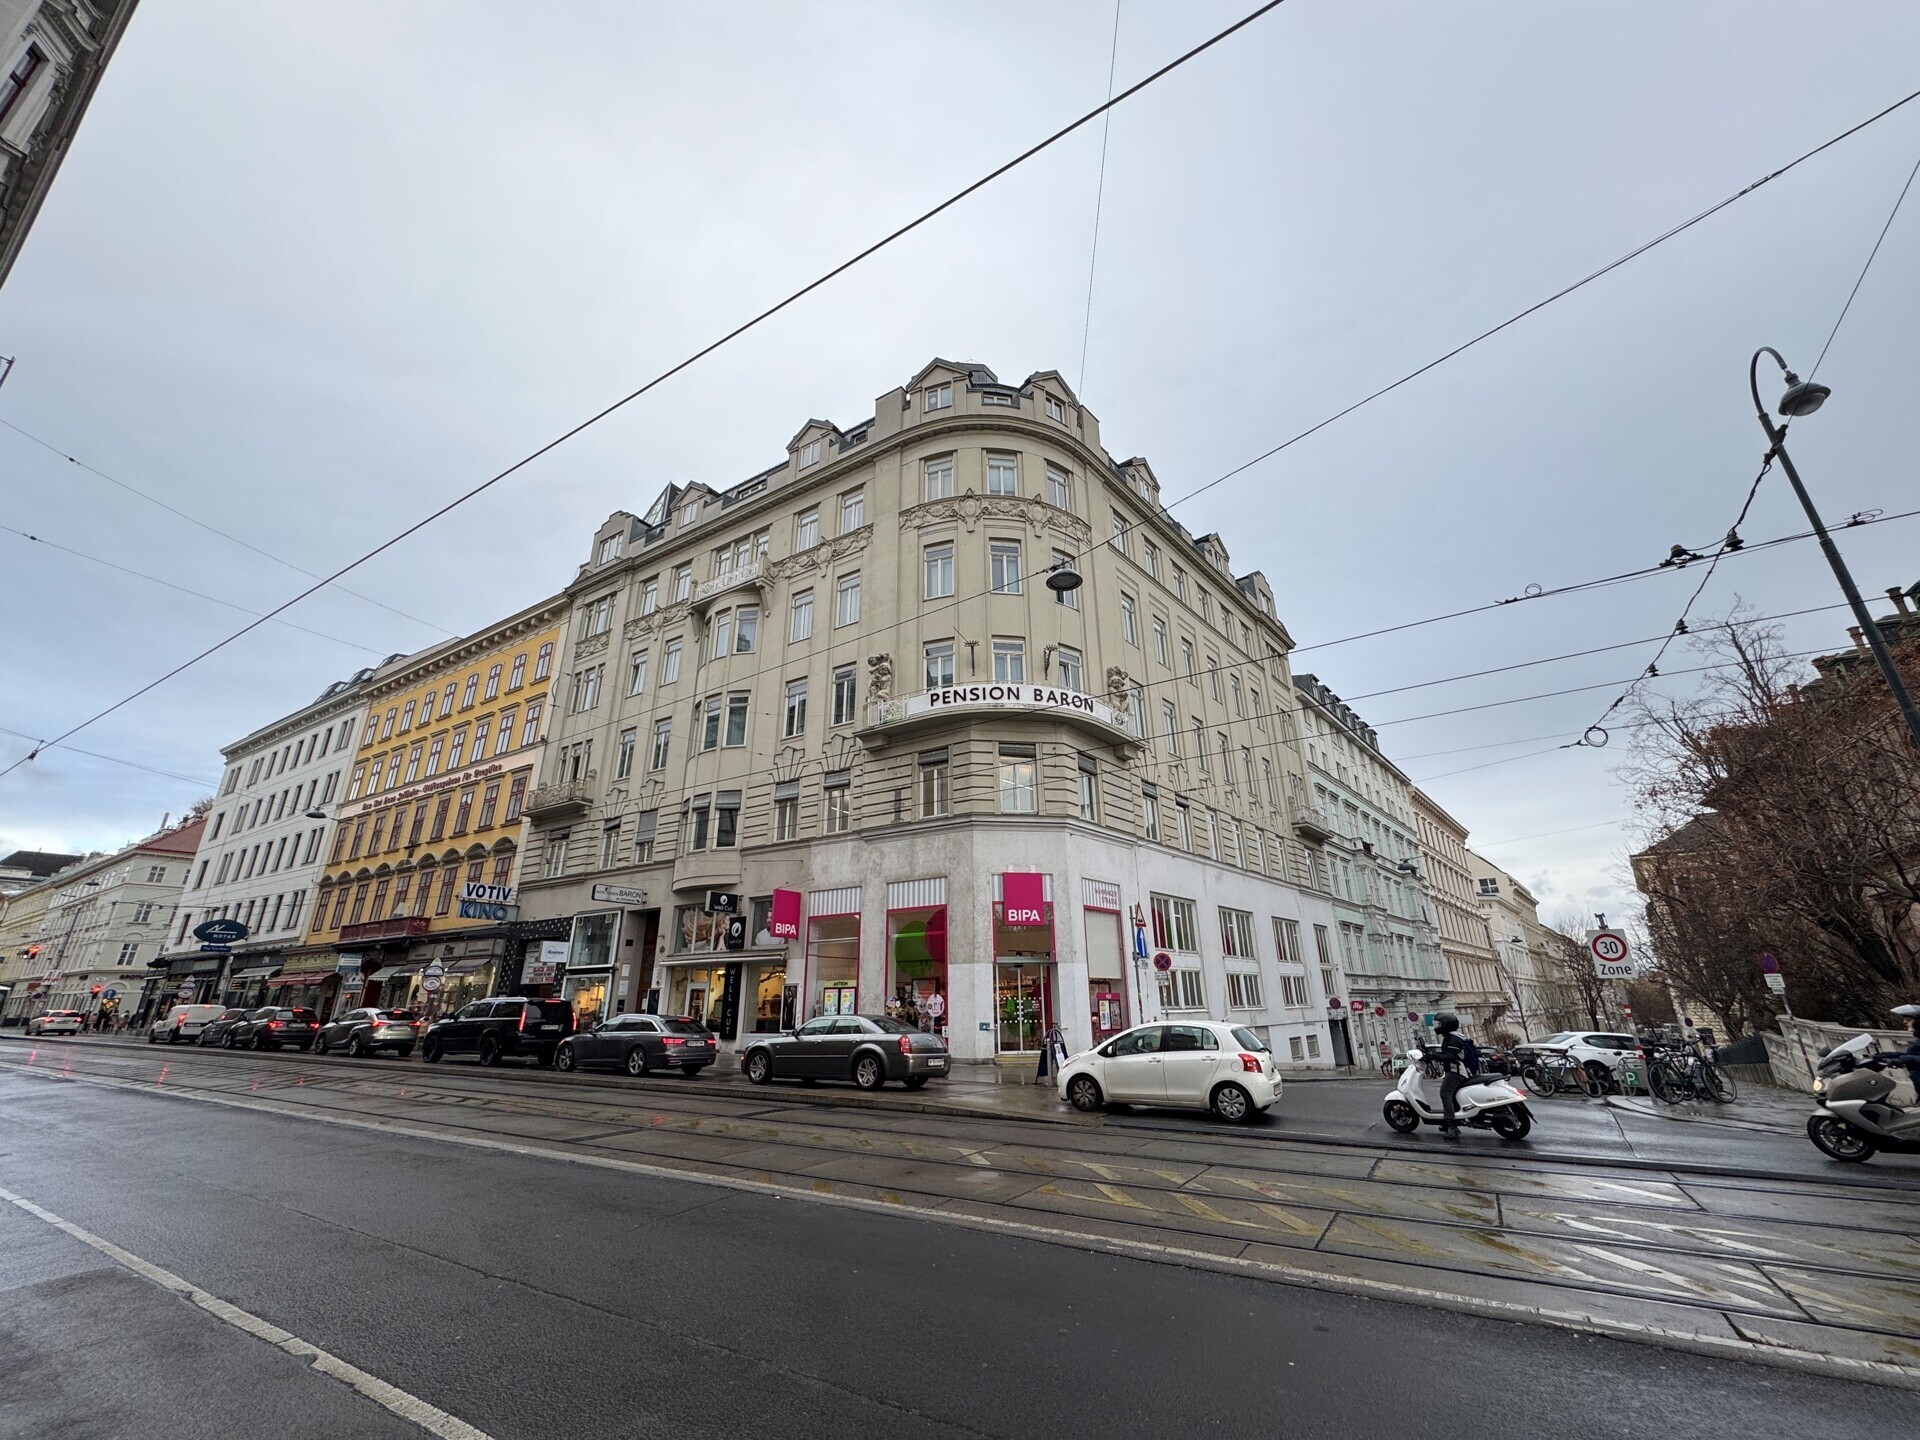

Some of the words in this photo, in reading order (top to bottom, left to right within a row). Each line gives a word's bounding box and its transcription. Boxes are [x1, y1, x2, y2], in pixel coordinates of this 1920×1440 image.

[930, 687, 1020, 707] PENSION
[1034, 688, 1094, 713] BARON
[466, 883, 512, 901] VOTIV
[619, 890, 642, 899] BARON
[460, 901, 508, 922] KINO
[1008, 909, 1041, 922] BIPA
[775, 922, 797, 935] BIPA
[1600, 941, 1619, 955] 30
[1599, 963, 1632, 976] Zone
[728, 967, 736, 1002] WELL
[1352, 1002, 1363, 1010] illy
[725, 1008, 733, 1034] CUT
[1625, 1072, 1636, 1085] P
